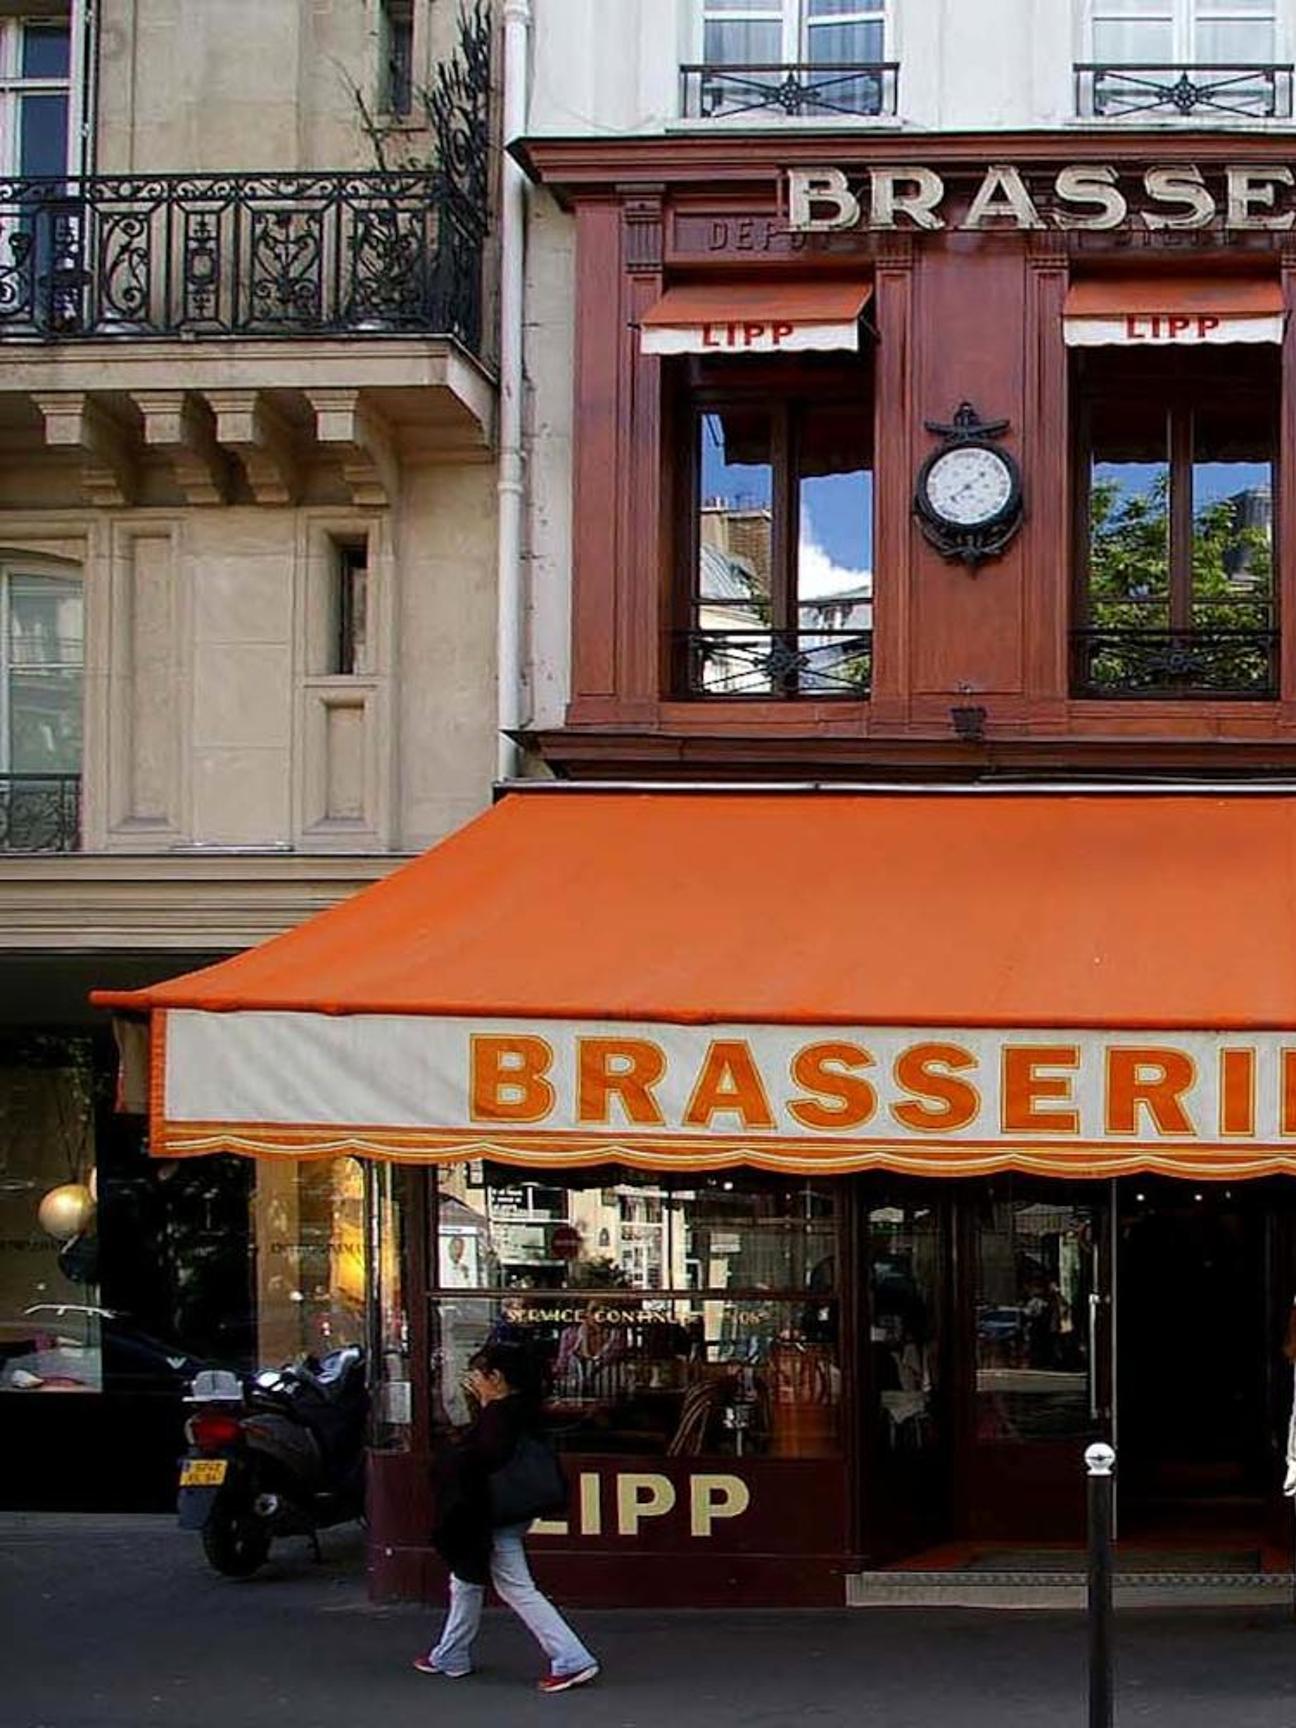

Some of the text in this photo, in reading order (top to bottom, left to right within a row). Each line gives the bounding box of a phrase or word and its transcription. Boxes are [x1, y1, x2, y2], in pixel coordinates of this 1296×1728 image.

[702, 323, 794, 347] LIPP
[1126, 316, 1220, 340] LIPP
[507, 1307, 585, 1324] SERVICE
